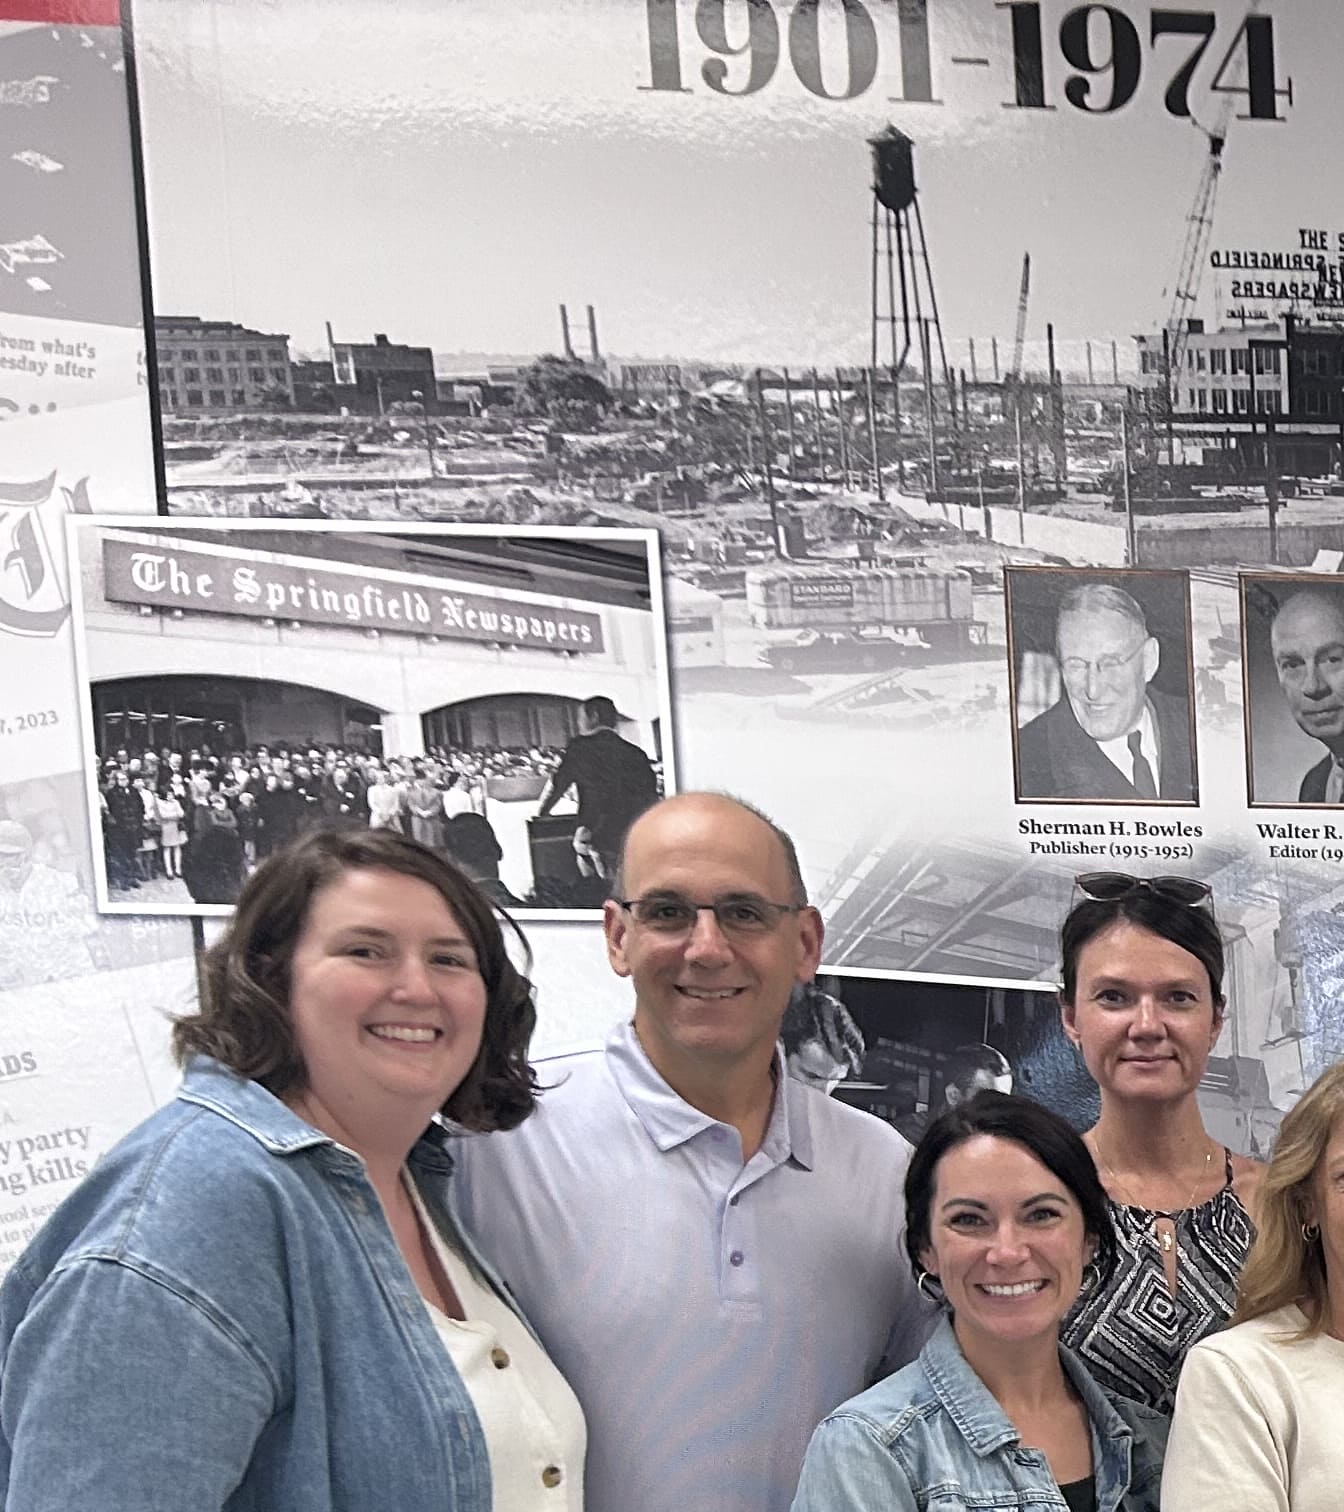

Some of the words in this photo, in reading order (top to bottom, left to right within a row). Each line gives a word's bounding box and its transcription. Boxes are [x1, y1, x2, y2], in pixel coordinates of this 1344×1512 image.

[1299, 229, 1328, 250] THE
[54, 360, 97, 379] after
[130, 552, 215, 600] The
[232, 566, 432, 624] Springfield
[441, 594, 593, 646] Newspapers
[17, 709, 60, 733] 2023
[1018, 818, 1107, 836] Sherman
[1109, 821, 1131, 836] H.
[1135, 820, 1203, 838] Bowles
[1255, 823, 1321, 840] Walter
[1323, 824, 1343, 840] R.
[1030, 840, 1107, 856] Publisher
[1109, 842, 1194, 860] (1915-1952)
[1269, 844, 1319, 859] Editor
[18, 1125, 91, 1161] party
[27, 1156, 89, 1187] kills
